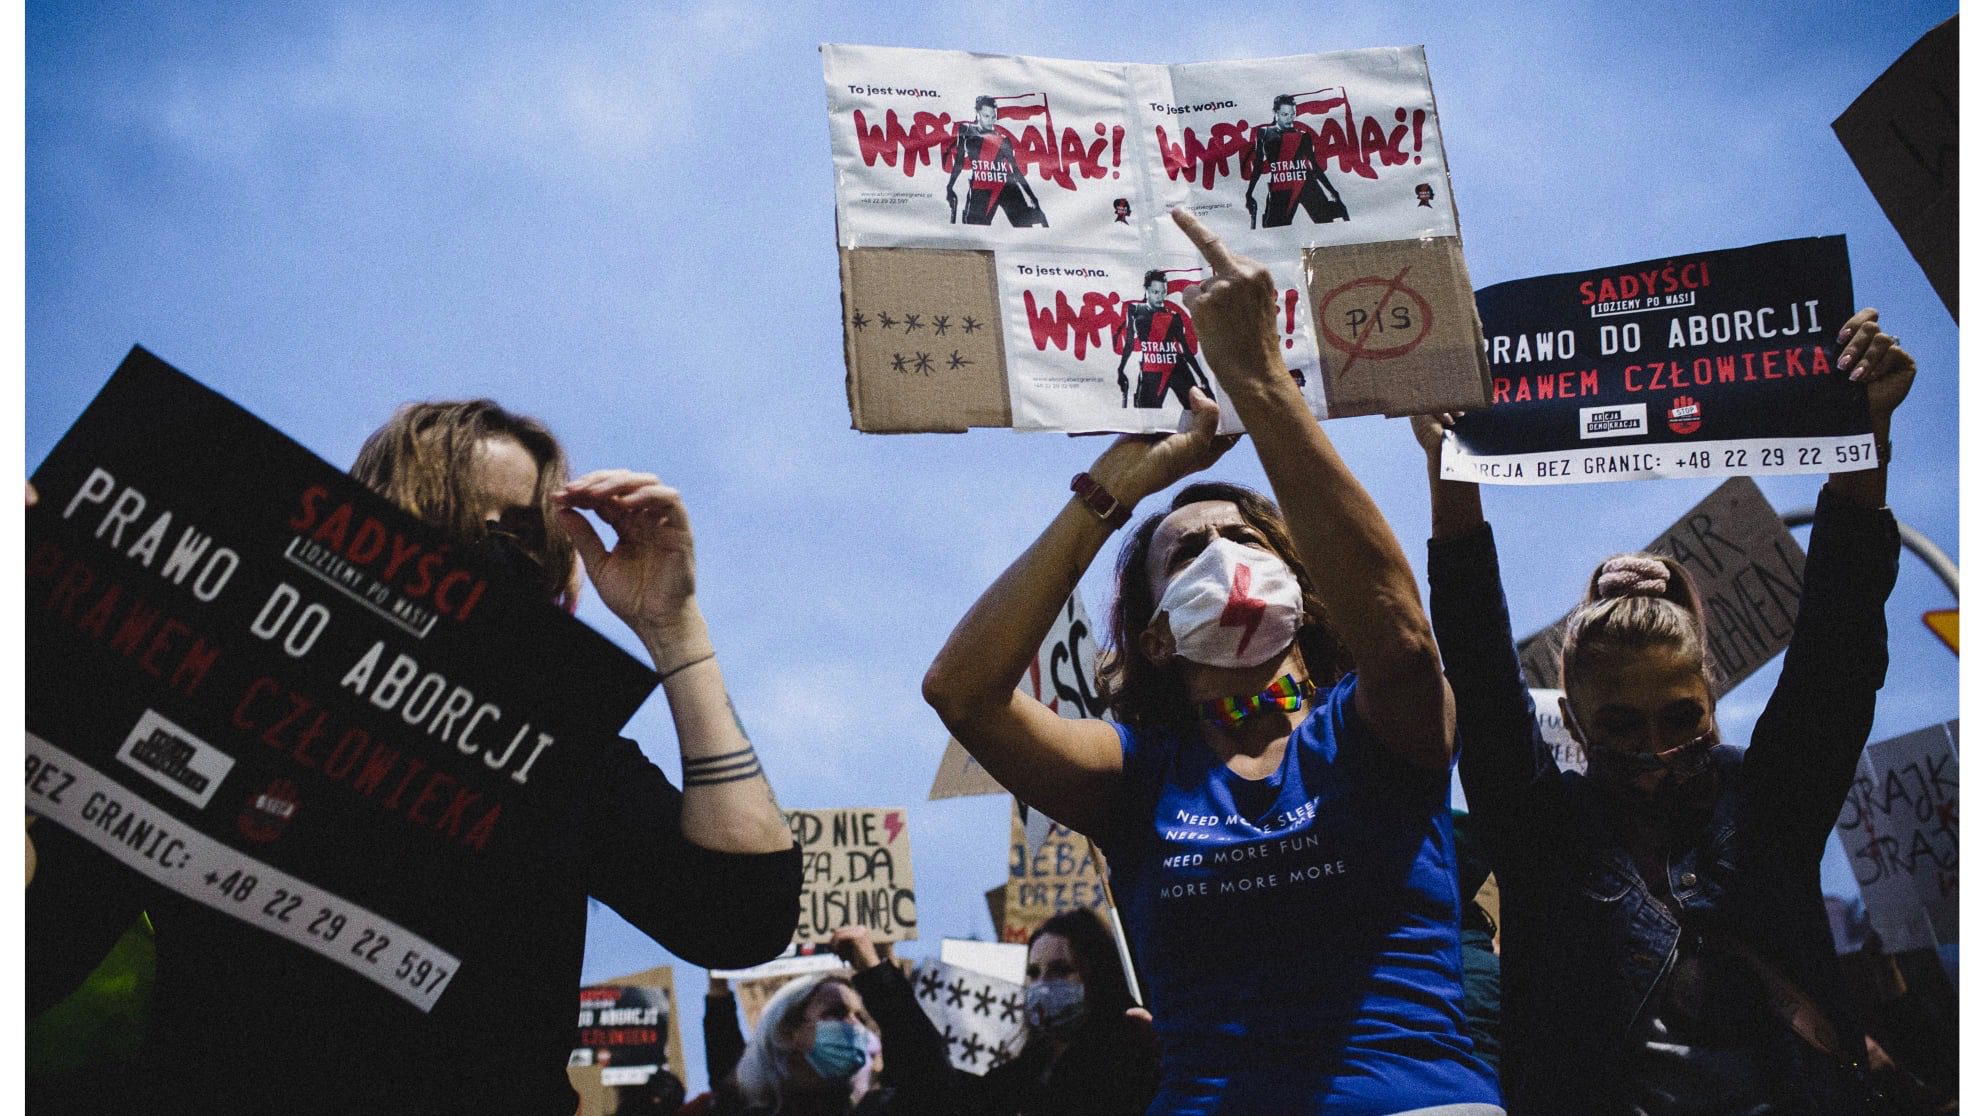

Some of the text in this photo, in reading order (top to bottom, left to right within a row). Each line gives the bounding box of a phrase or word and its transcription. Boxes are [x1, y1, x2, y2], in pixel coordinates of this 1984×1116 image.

[848, 85, 865, 95] To
[866, 85, 893, 97] jest
[1150, 102, 1165, 112] To
[1167, 103, 1191, 115] jest
[971, 159, 1007, 173] STRAJK
[974, 171, 1008, 183] KOBIET
[1270, 159, 1307, 173] STRAJK
[1273, 170, 1307, 182] KOBIET
[1017, 265, 1033, 275] To
[1036, 265, 1061, 277] jest
[1579, 261, 1710, 304] SADYŚCI
[1597, 293, 1690, 313] IDZIEMY PO WAS!
[1483, 300, 1823, 364] RAWO DO ABORCJI
[1141, 341, 1177, 354] STRAJK
[1144, 352, 1178, 364] KOBIET
[1493, 346, 1831, 404] RAWEM CZŁOWIEKA
[1538, 460, 1570, 477] BEZ
[1584, 453, 1661, 474] GRANIC:
[1675, 451, 1711, 470] +48
[1724, 449, 1748, 468] 22
[1761, 448, 1785, 467] 29
[1799, 446, 1823, 466] 22
[1836, 443, 1872, 463] 597
[288, 484, 488, 622] SADYŚCI
[63, 468, 240, 602] PRAWO
[250, 583, 331, 658] DO
[341, 641, 554, 786] ABORCJI
[27, 541, 222, 695] PRAWEM
[230, 676, 505, 854] CZŁOWIEKA
[834, 812, 880, 847] NIE
[1176, 808, 1219, 827] NEED
[1163, 834, 1320, 869] NEED MORE FUN
[81, 790, 191, 871] GRANIC:
[204, 867, 258, 903] +48
[262, 890, 306, 924] 22
[307, 907, 348, 943] 29
[352, 928, 392, 964] 22
[396, 950, 449, 996] 597
[1160, 860, 1347, 899] MORE MORE MORE
